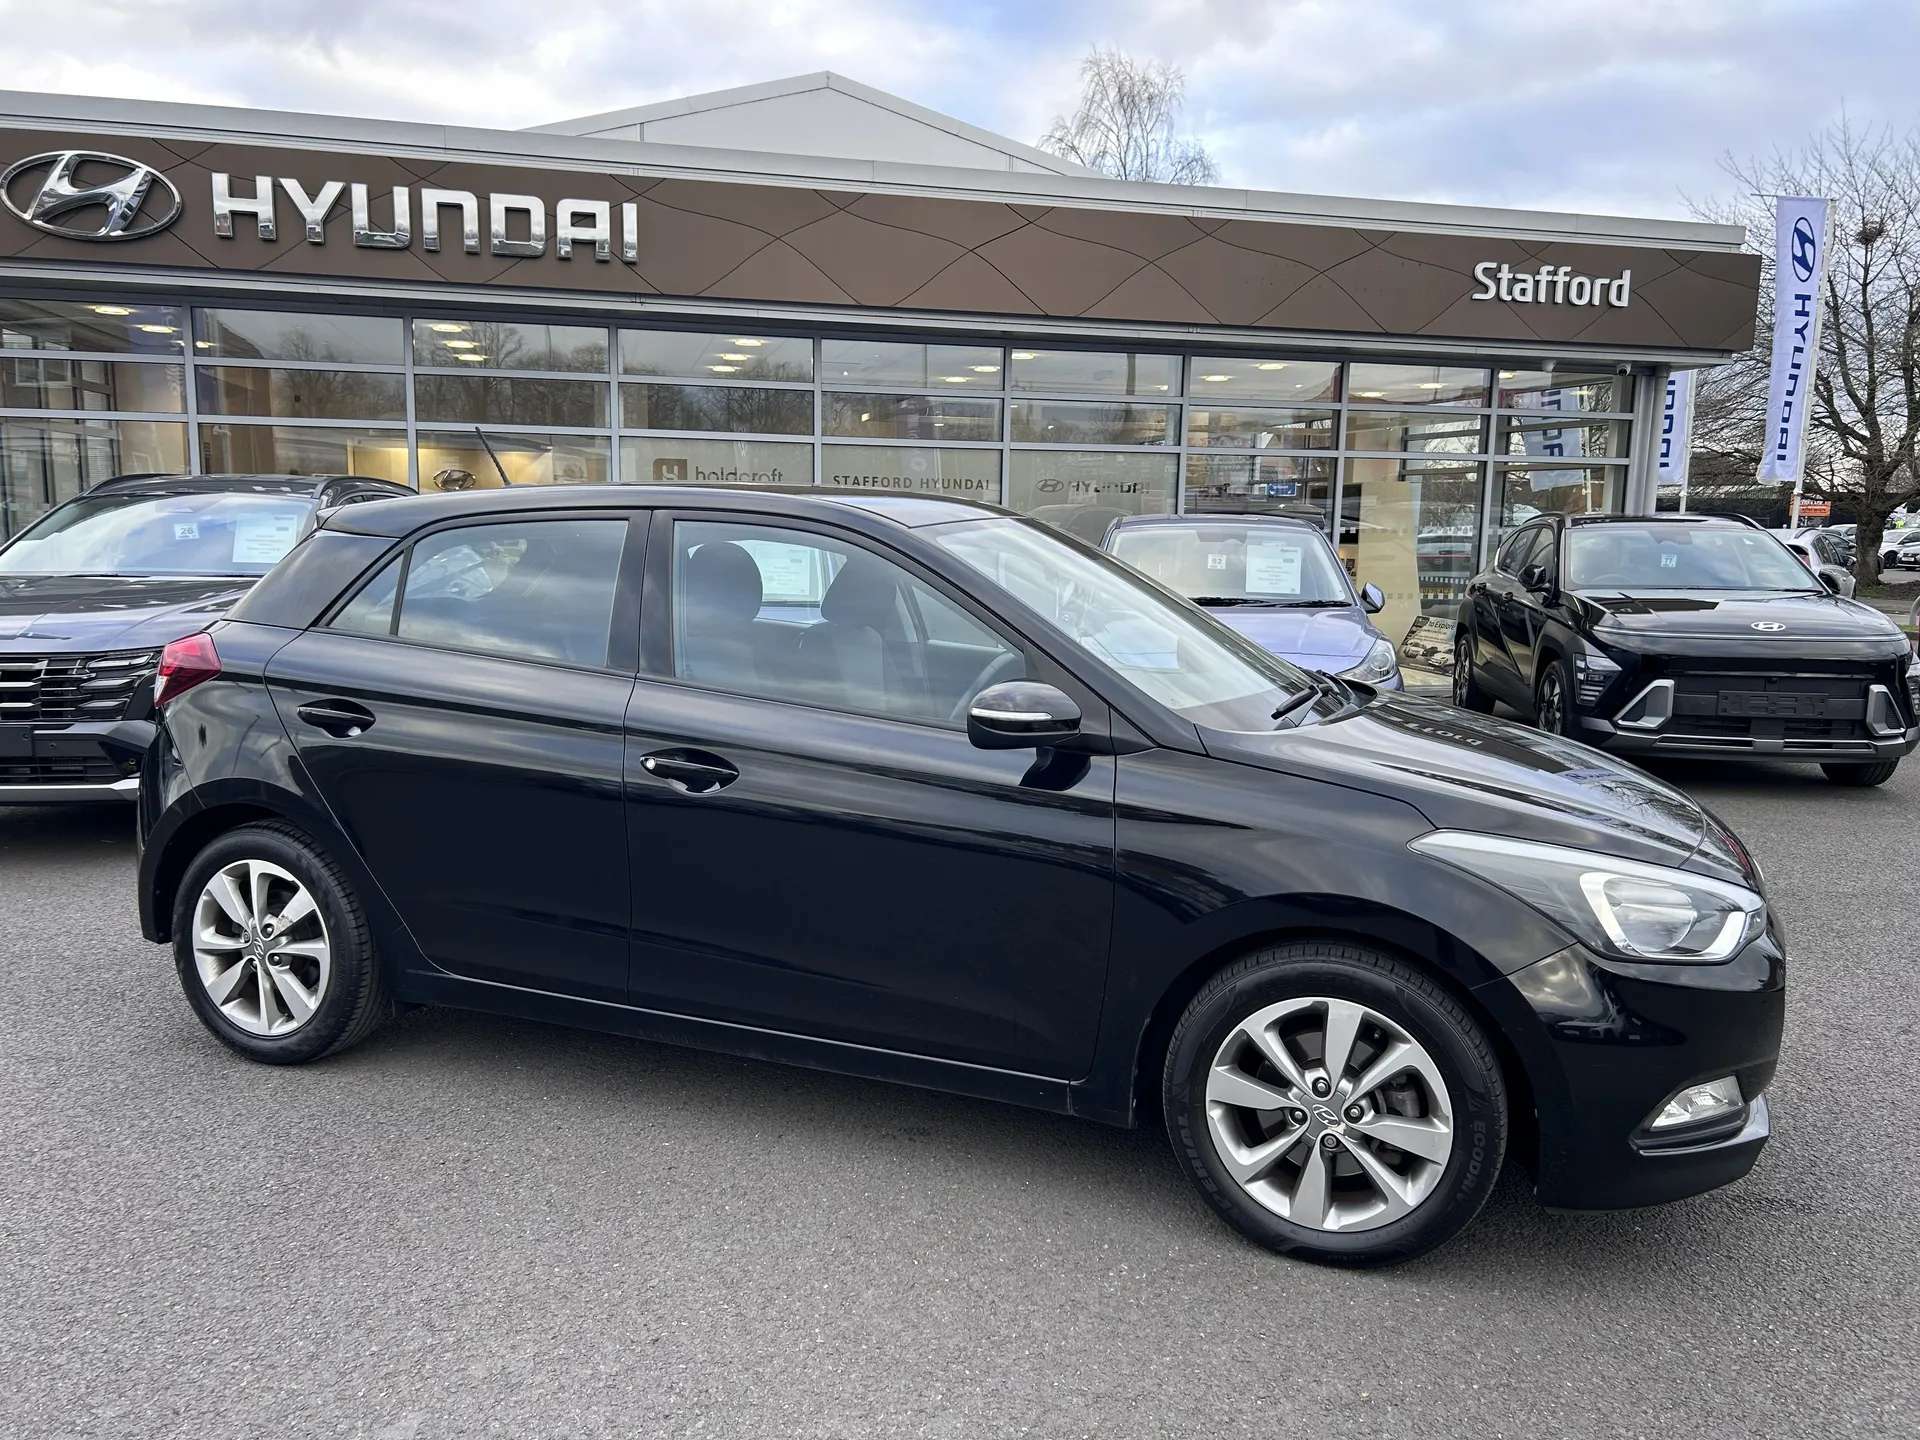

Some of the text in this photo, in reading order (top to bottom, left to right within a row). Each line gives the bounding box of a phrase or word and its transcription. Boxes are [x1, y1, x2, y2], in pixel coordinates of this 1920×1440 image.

[211, 172, 639, 265] HYUNDAI
[1471, 261, 1632, 307] Stafford
[1776, 293, 1812, 461] HYUNDAI
[832, 475, 990, 491] STAFFORD HYUNDAI
[1434, 620, 1456, 631] Explore
